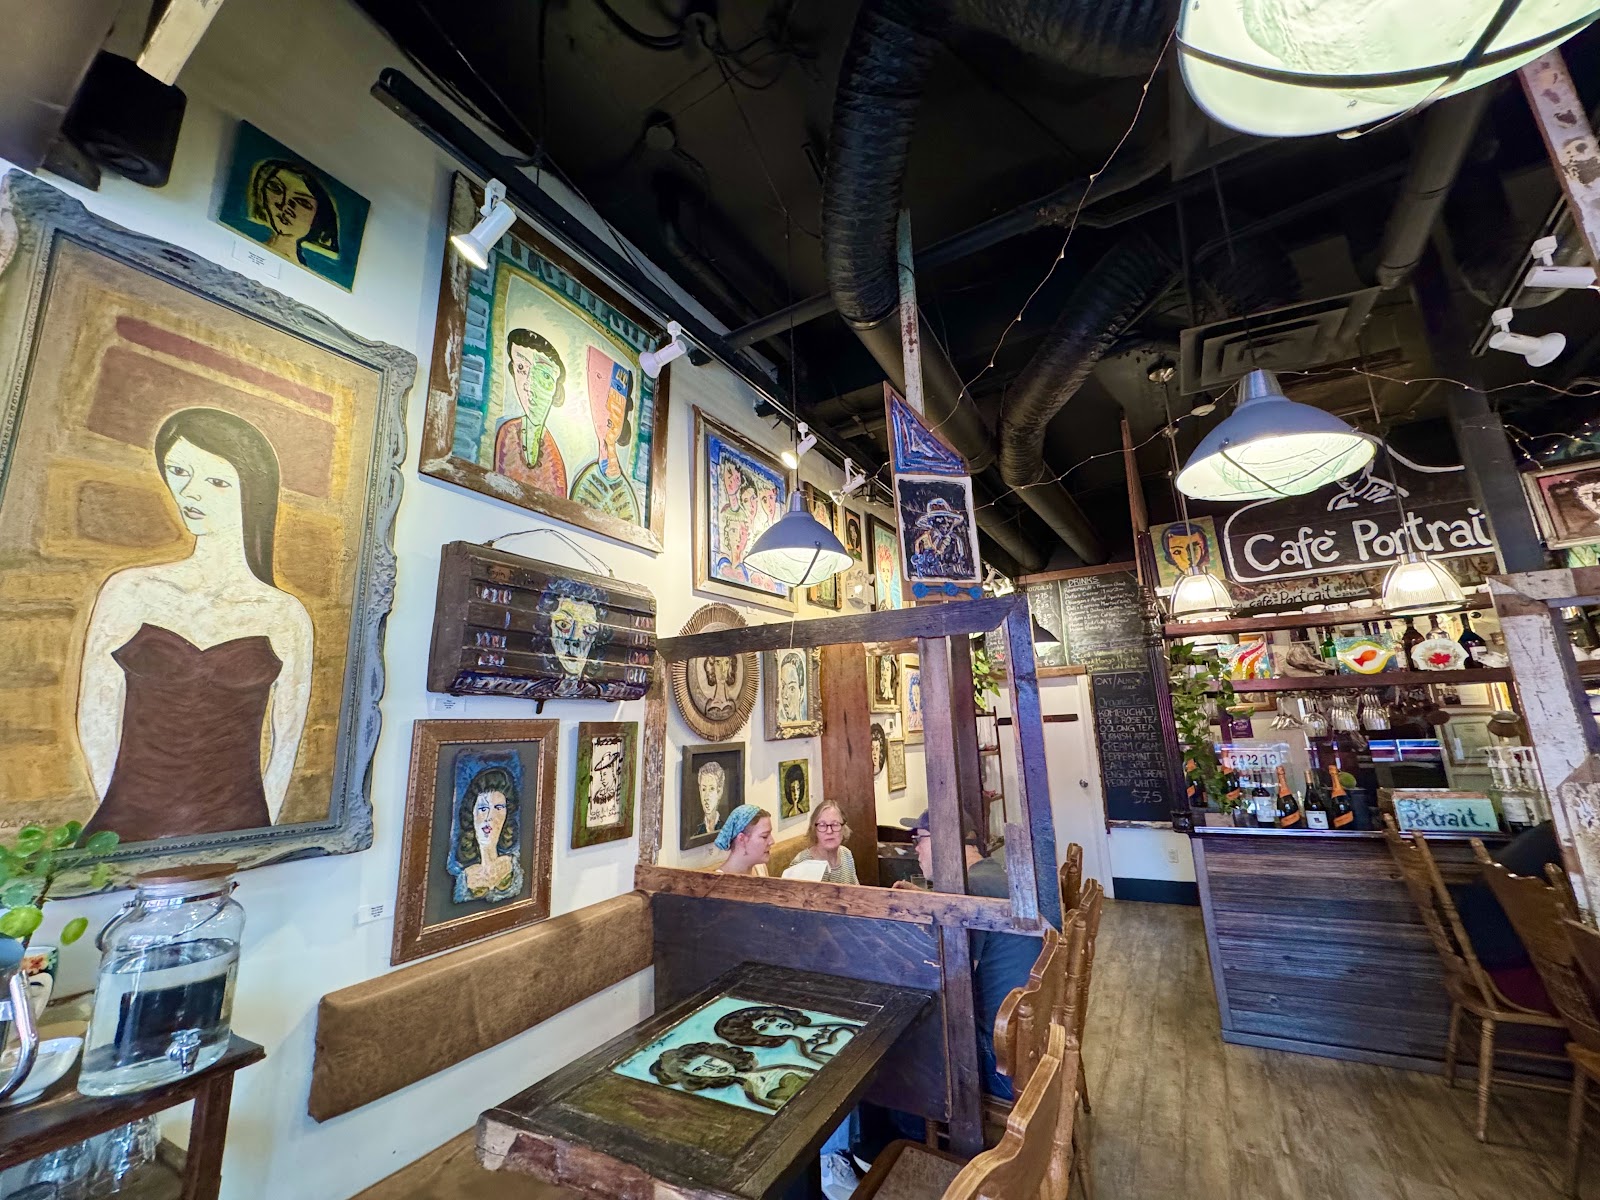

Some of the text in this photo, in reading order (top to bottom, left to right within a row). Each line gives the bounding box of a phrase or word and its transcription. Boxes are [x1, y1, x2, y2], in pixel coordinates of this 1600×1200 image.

[1352, 507, 1493, 561] Portrai
[1067, 576, 1100, 588] DRINKS
[1102, 742, 1134, 752] CREAM
